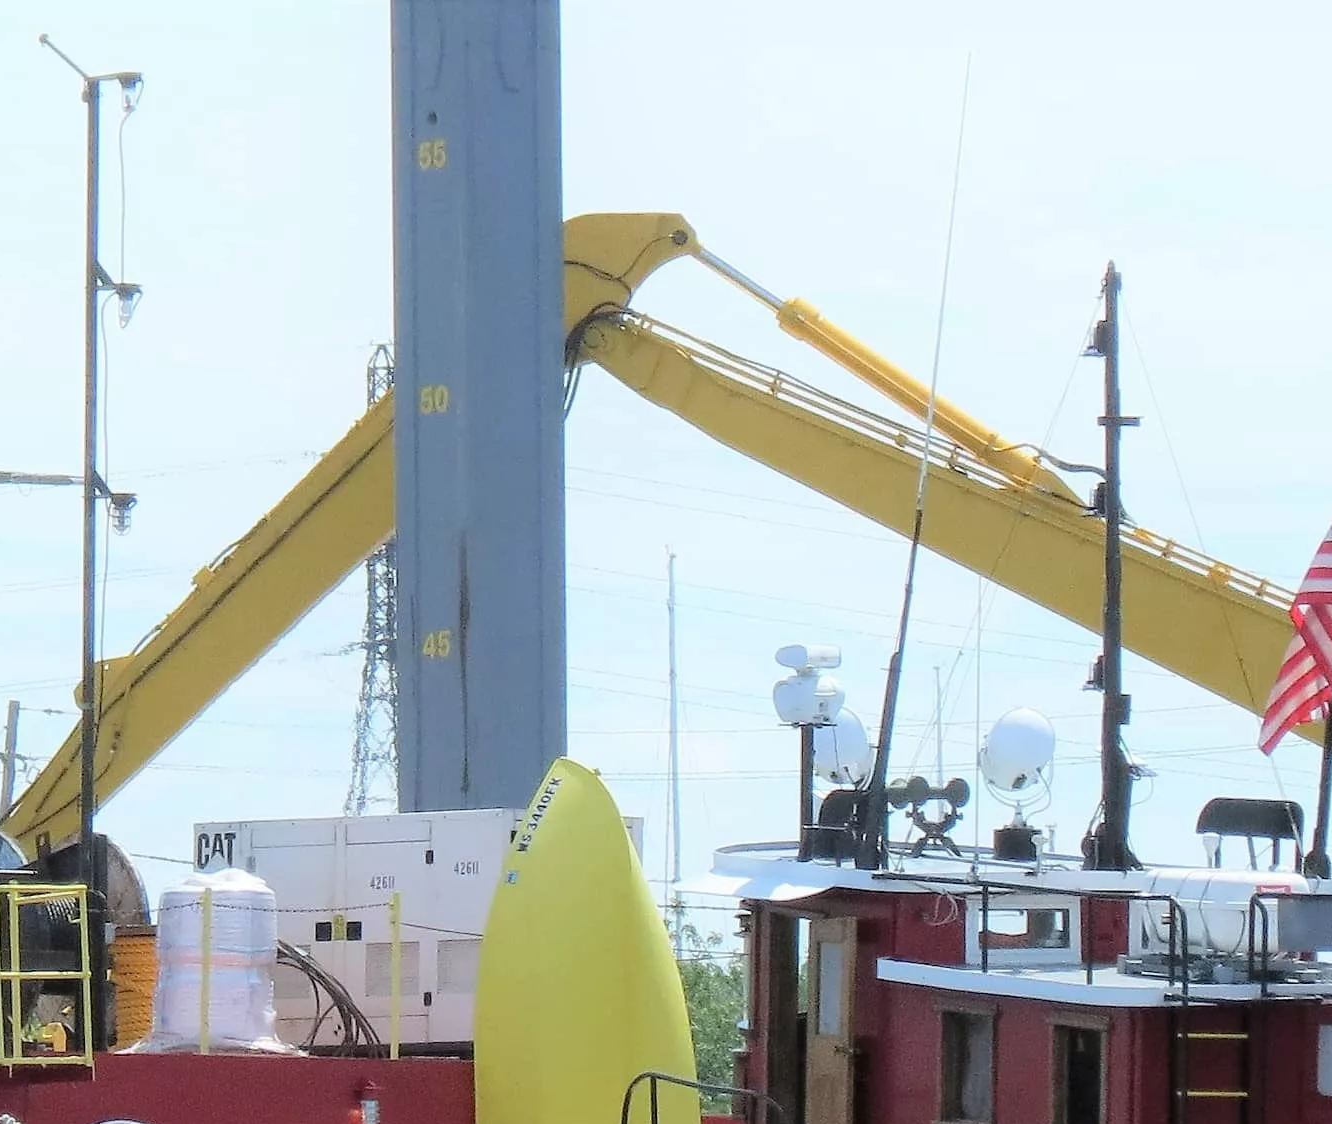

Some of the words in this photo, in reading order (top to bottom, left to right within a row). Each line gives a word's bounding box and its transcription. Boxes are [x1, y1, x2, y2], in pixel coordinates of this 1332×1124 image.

[420, 384, 449, 414] 50
[423, 630, 451, 658] 45
[197, 832, 236, 870] CAT
[454, 860, 479, 875] 42611
[370, 875, 395, 890] 42611
